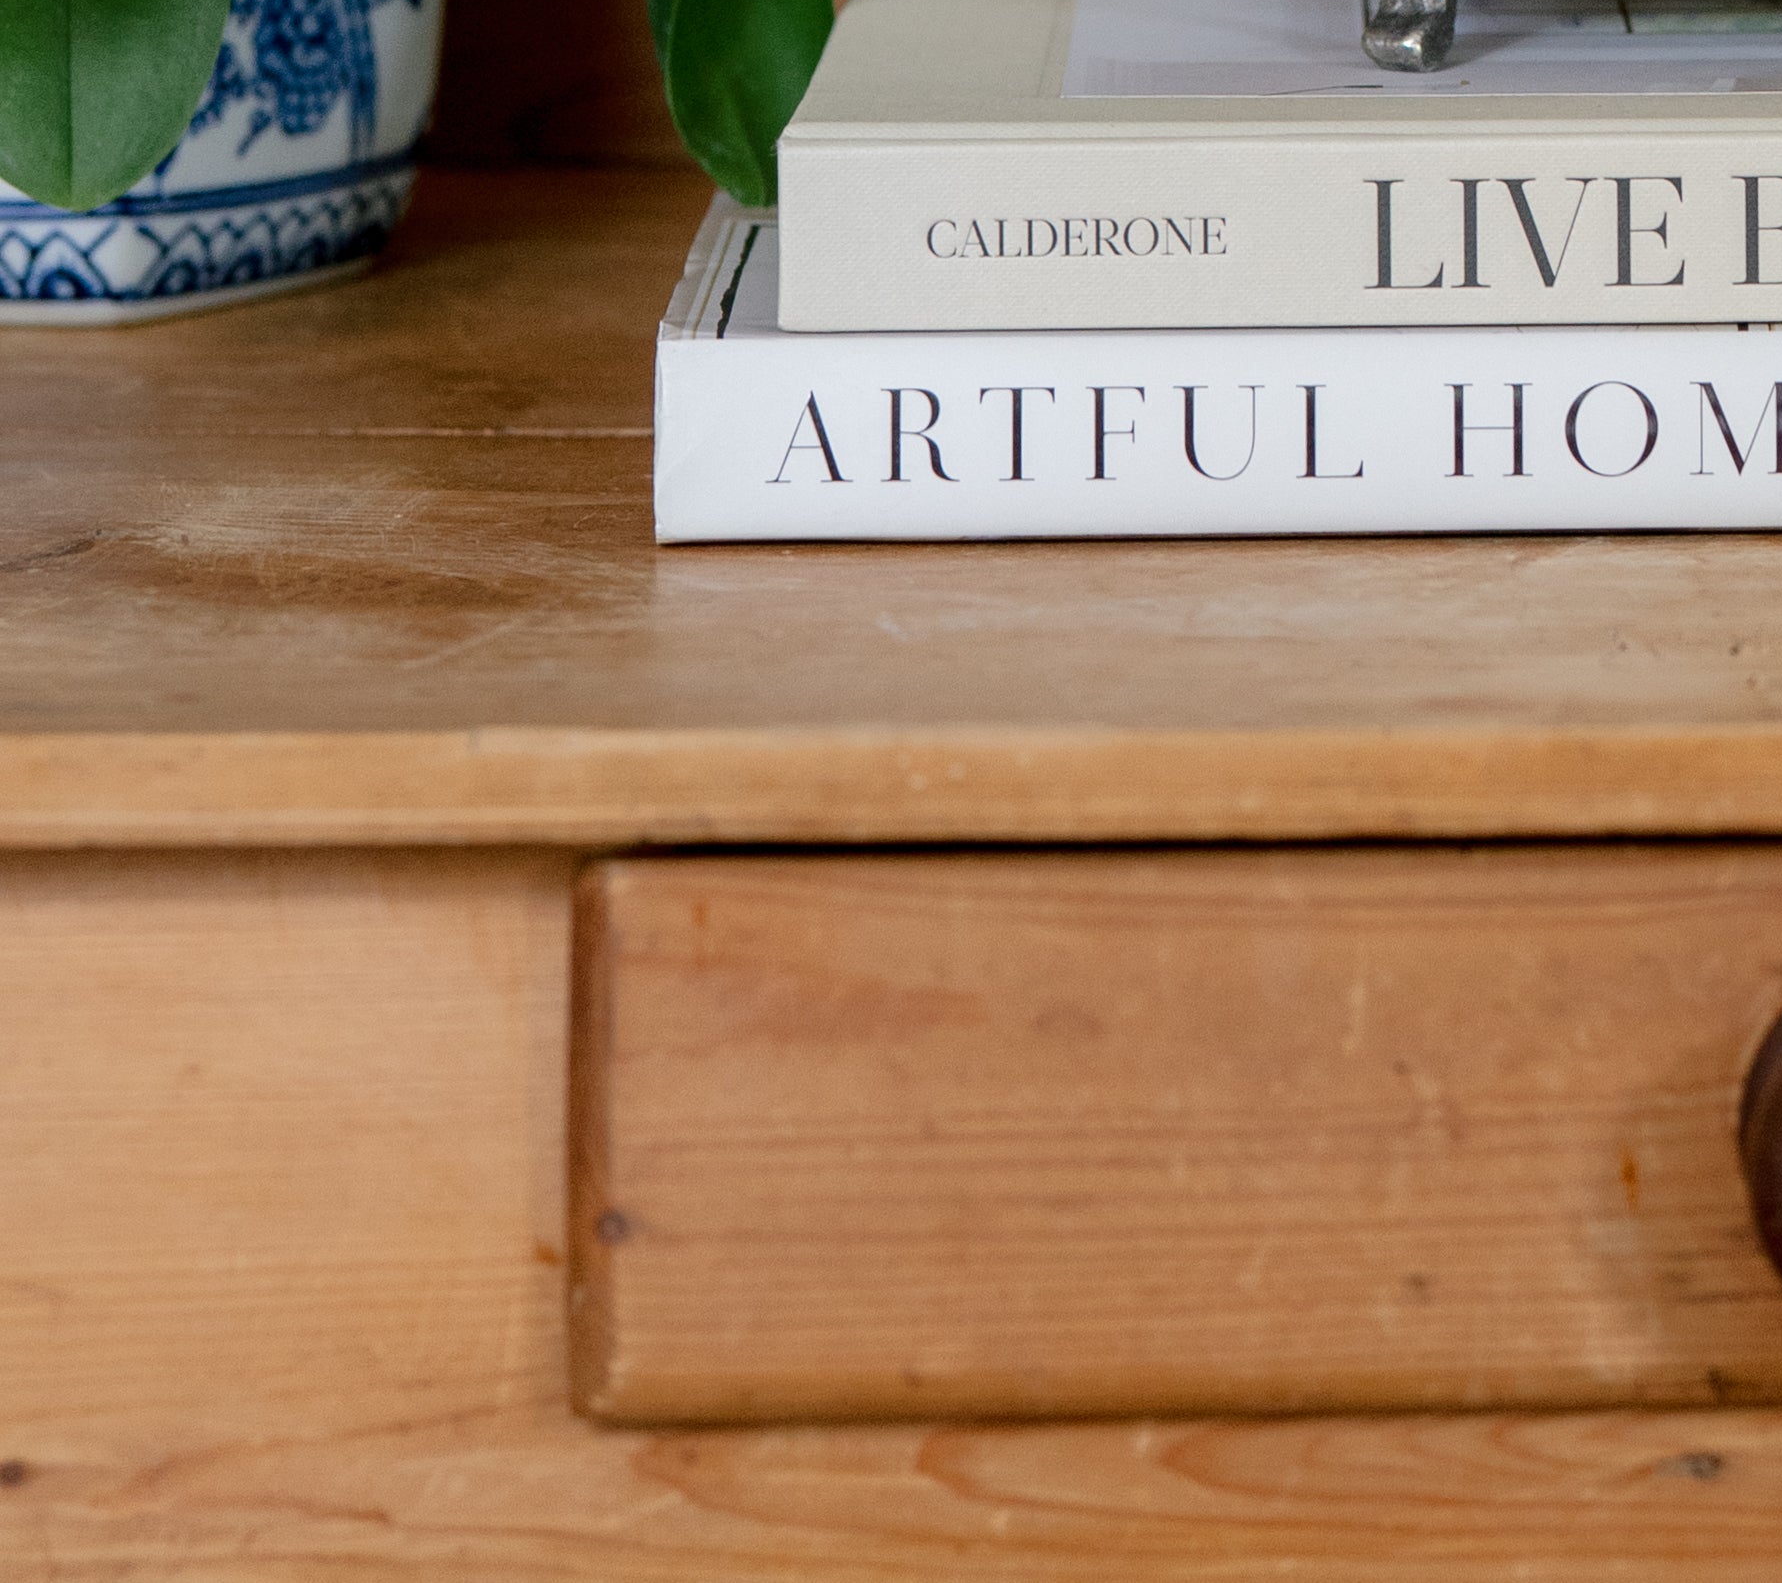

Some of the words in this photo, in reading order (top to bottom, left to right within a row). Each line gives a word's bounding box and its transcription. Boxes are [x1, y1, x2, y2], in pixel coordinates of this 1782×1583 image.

[925, 216, 1228, 260] CALDERONE
[1361, 175, 1687, 290] LIVE
[763, 384, 1365, 484] ARTFUL
